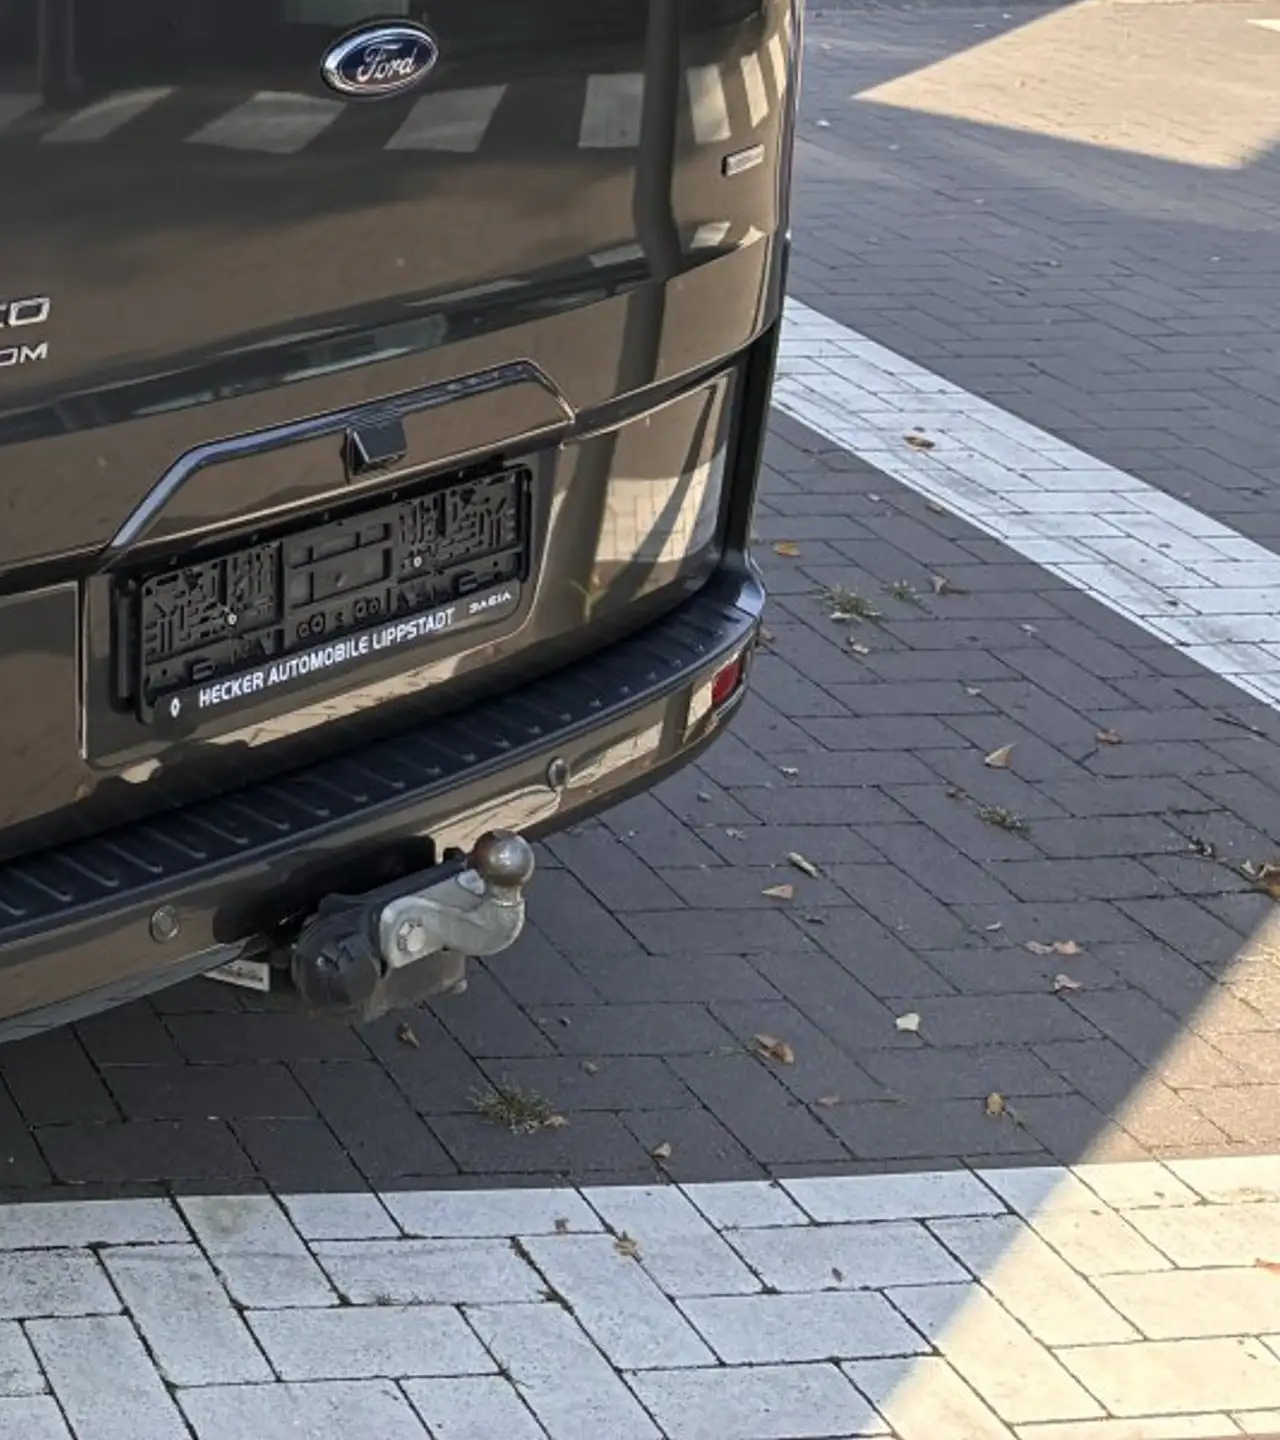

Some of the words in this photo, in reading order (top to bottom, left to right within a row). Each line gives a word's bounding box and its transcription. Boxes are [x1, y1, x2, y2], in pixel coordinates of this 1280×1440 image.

[357, 42, 420, 82] Ford
[200, 671, 263, 708] HECKER
[268, 635, 369, 686] AUTOMOBILE
[373, 608, 456, 652] LIPPSTADT
